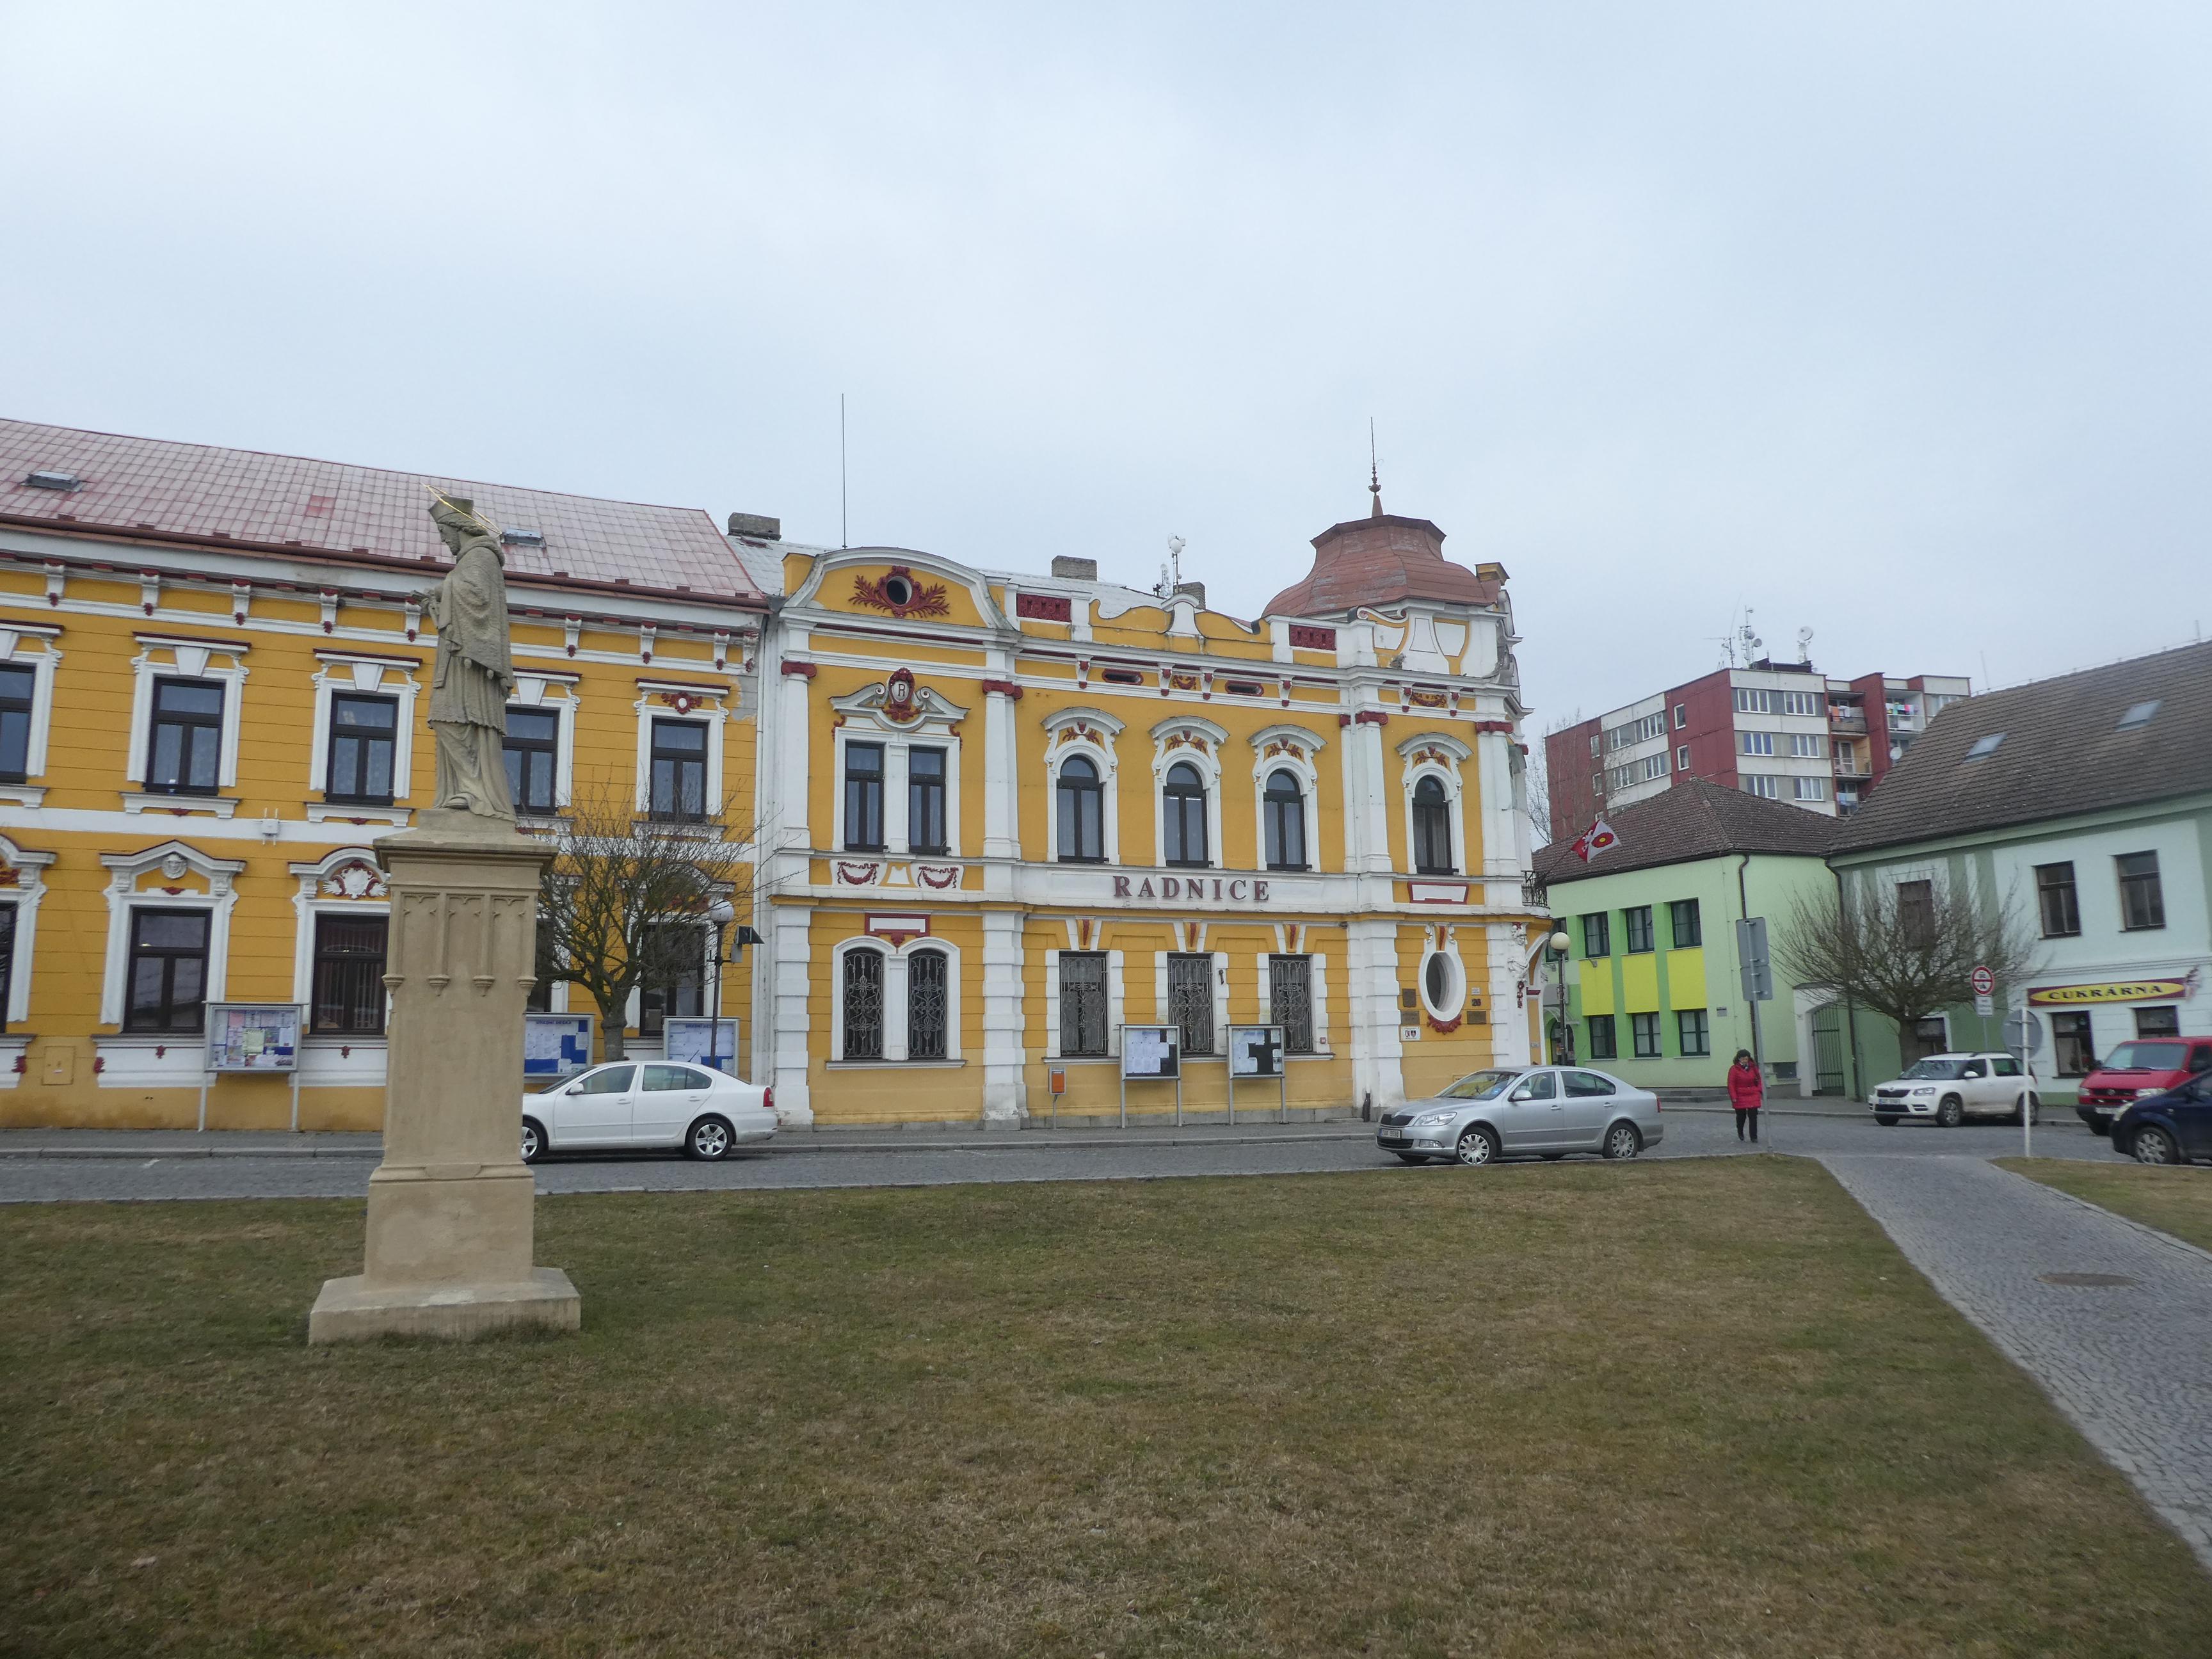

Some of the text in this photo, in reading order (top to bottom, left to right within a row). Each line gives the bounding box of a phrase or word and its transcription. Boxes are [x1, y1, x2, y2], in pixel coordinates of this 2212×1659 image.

[897, 684, 906, 696] R
[1113, 876, 1269, 901] RADNICE
[2049, 984, 2163, 1000] CUKRÁRNA
